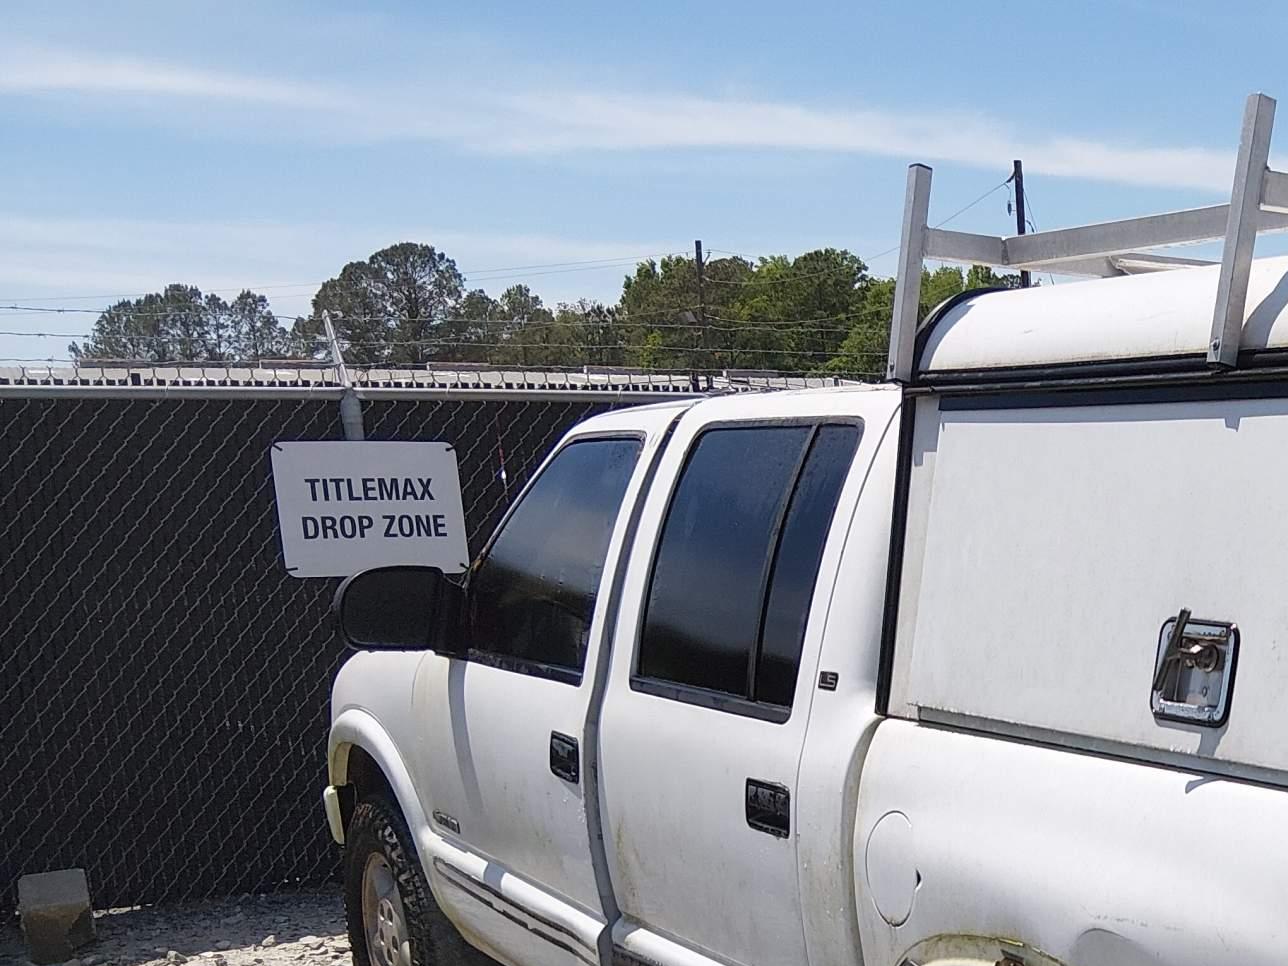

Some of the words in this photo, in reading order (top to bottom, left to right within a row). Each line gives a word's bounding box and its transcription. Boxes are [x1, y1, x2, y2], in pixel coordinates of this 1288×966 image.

[304, 478, 435, 501] TITLEMAX
[301, 516, 374, 539] DROP
[382, 514, 448, 538] ZONE
